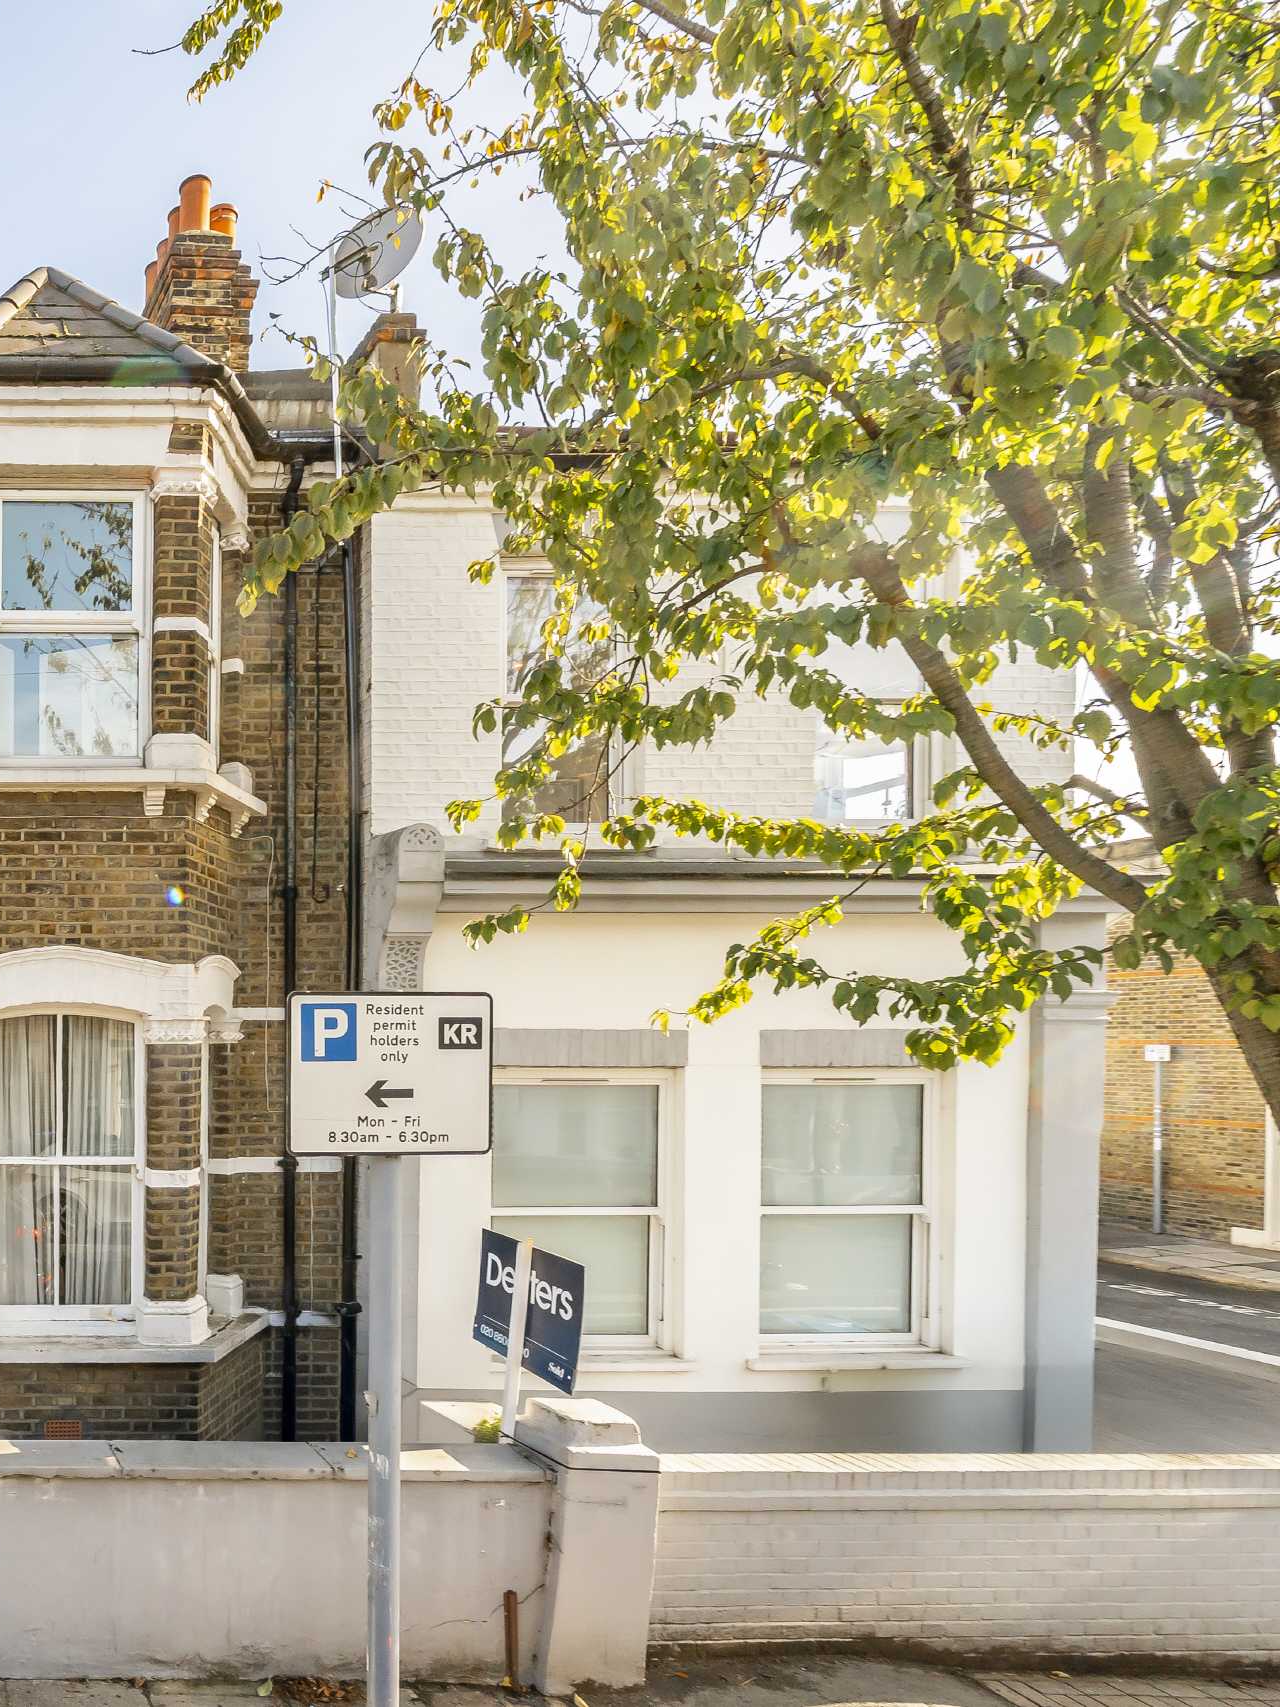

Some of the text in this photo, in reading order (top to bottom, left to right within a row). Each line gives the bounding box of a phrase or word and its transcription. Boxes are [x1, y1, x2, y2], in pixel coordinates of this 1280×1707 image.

[365, 1004, 424, 1016] Resident
[373, 1020, 417, 1031] permit
[313, 1008, 349, 1057] P
[443, 1023, 478, 1045] KR
[370, 1035, 420, 1046] holders
[380, 1051, 409, 1064] only
[357, 1116, 385, 1127] Mon
[404, 1116, 421, 1127] Fri
[328, 1132, 379, 1143] 8.30am
[398, 1132, 449, 1144] 6.30pm
[486, 1251, 573, 1321] Deters
